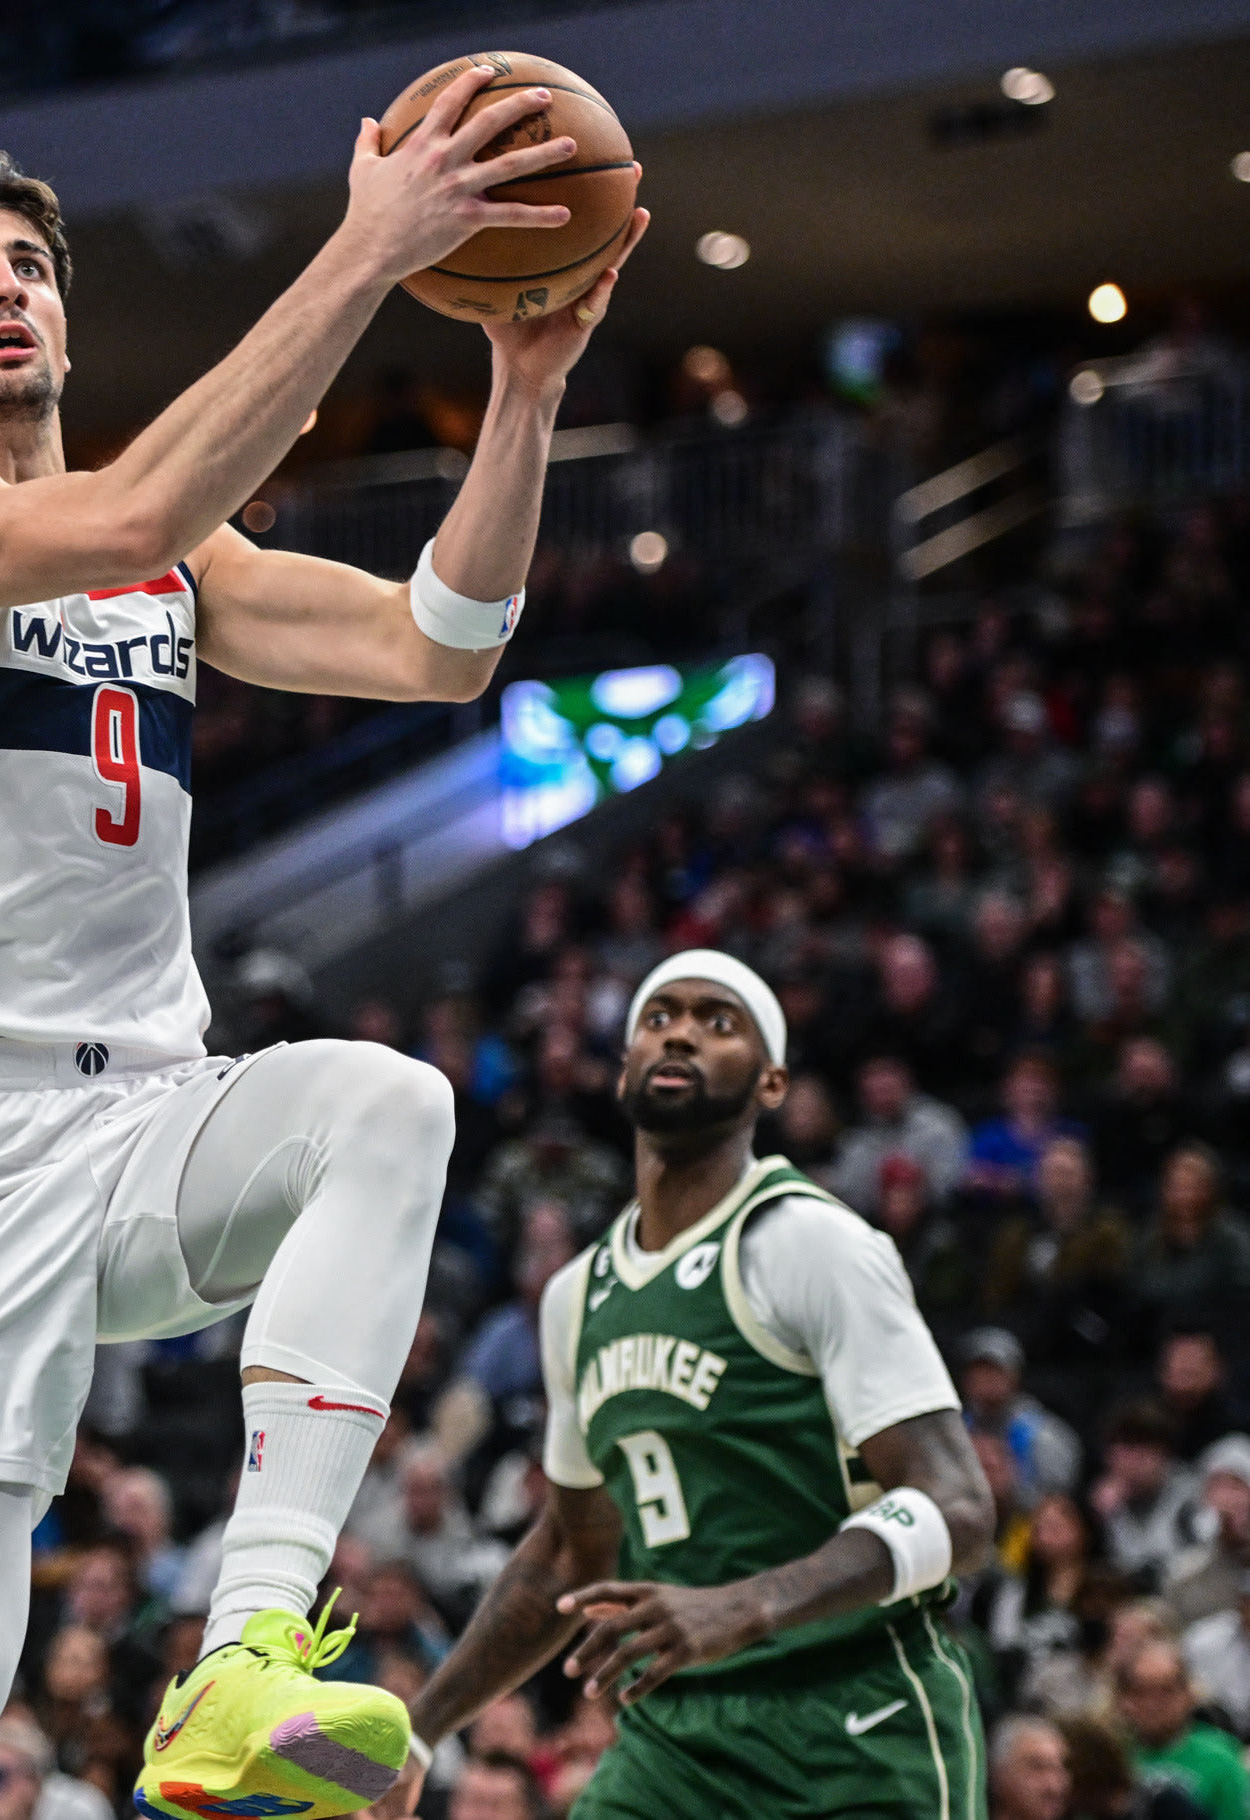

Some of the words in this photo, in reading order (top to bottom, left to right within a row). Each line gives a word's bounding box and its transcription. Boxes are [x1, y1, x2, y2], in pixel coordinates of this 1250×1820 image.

[12, 609, 194, 679] wzards
[91, 683, 142, 851] 9
[579, 1332, 728, 1434] ILWAUKEE
[616, 1429, 691, 1549] 9
